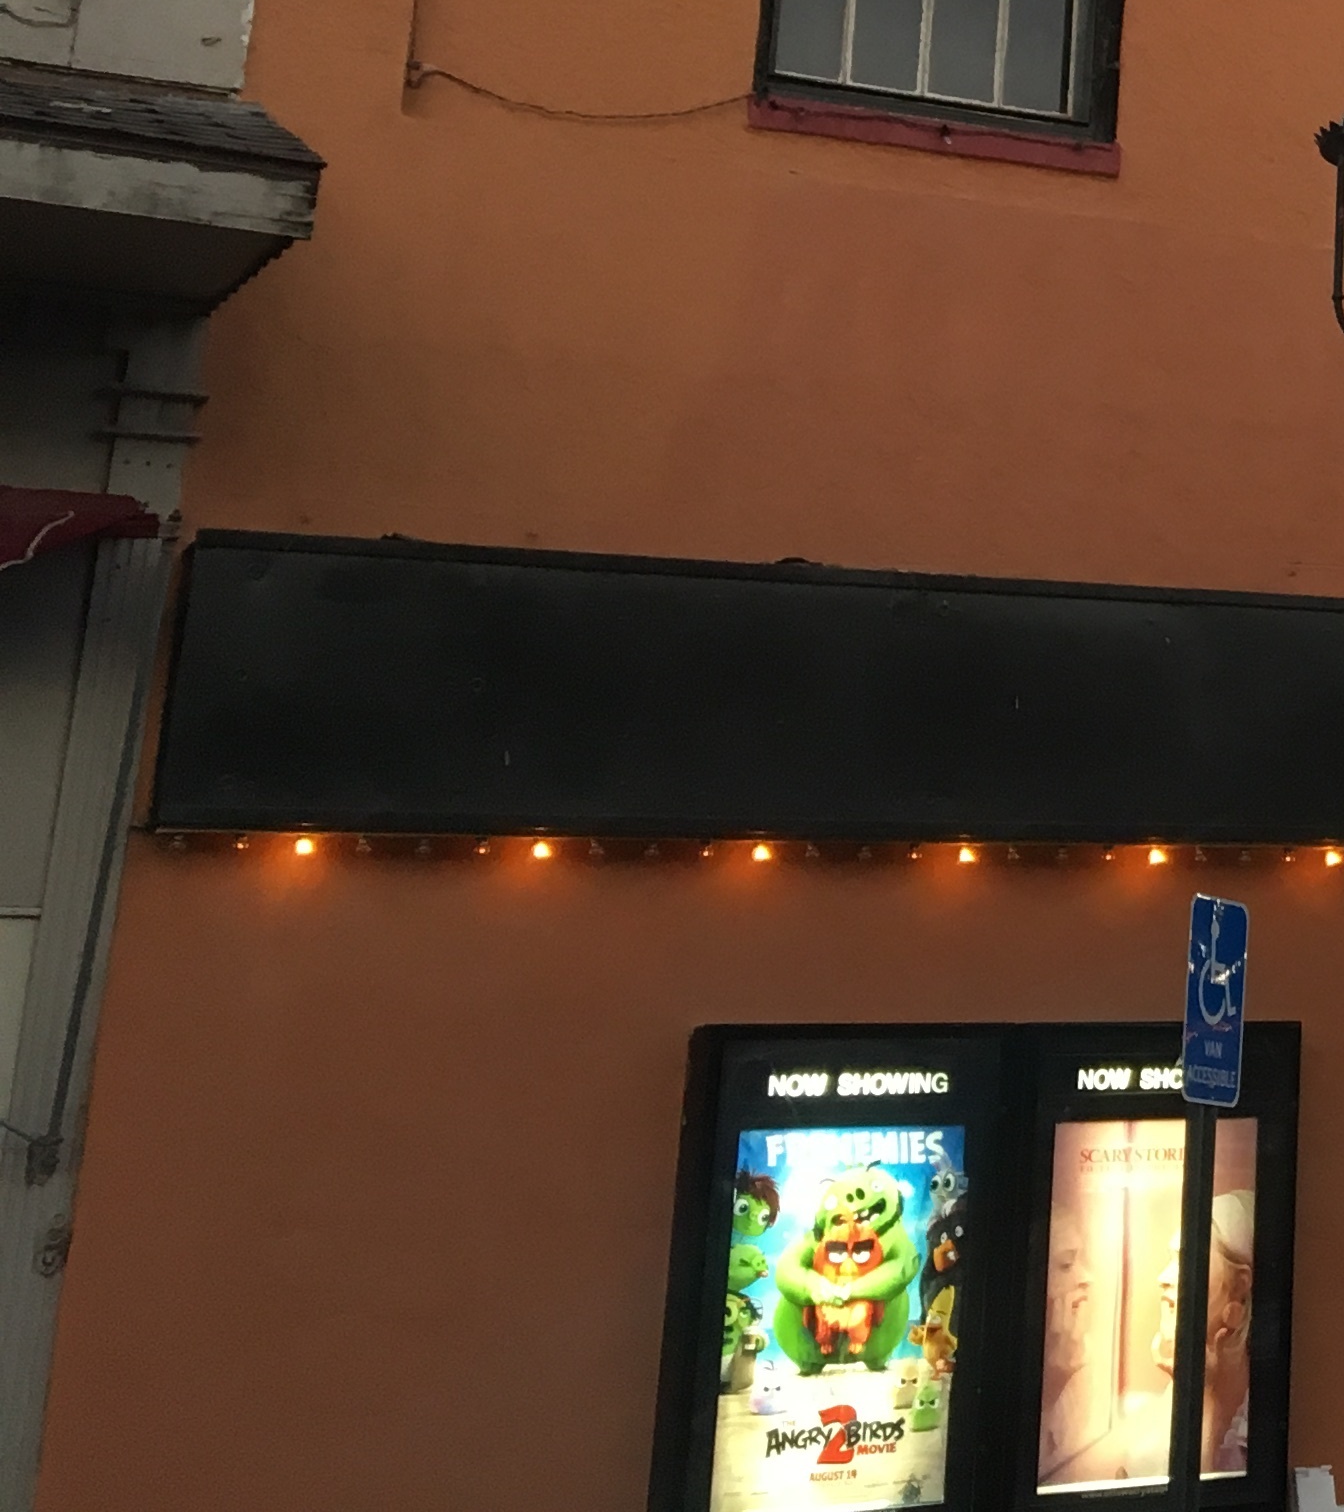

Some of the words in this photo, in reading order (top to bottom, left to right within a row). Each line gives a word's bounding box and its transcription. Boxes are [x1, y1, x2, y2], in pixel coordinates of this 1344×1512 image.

[1204, 1039, 1223, 1060] VAN
[768, 1072, 829, 1097] NOW
[836, 1072, 949, 1097] SHOWING
[1077, 1068, 1132, 1091] NOW
[1187, 1065, 1237, 1088] ACCESSIBLE
[1080, 1146, 1133, 1164] SCARY
[1135, 1146, 1184, 1163] STORI
[765, 1425, 834, 1458] ANGRY
[816, 1404, 858, 1465] 2
[844, 1417, 906, 1449] BIRDS
[856, 1441, 897, 1455] MOVIE
[809, 1470, 844, 1482] AUGUST
